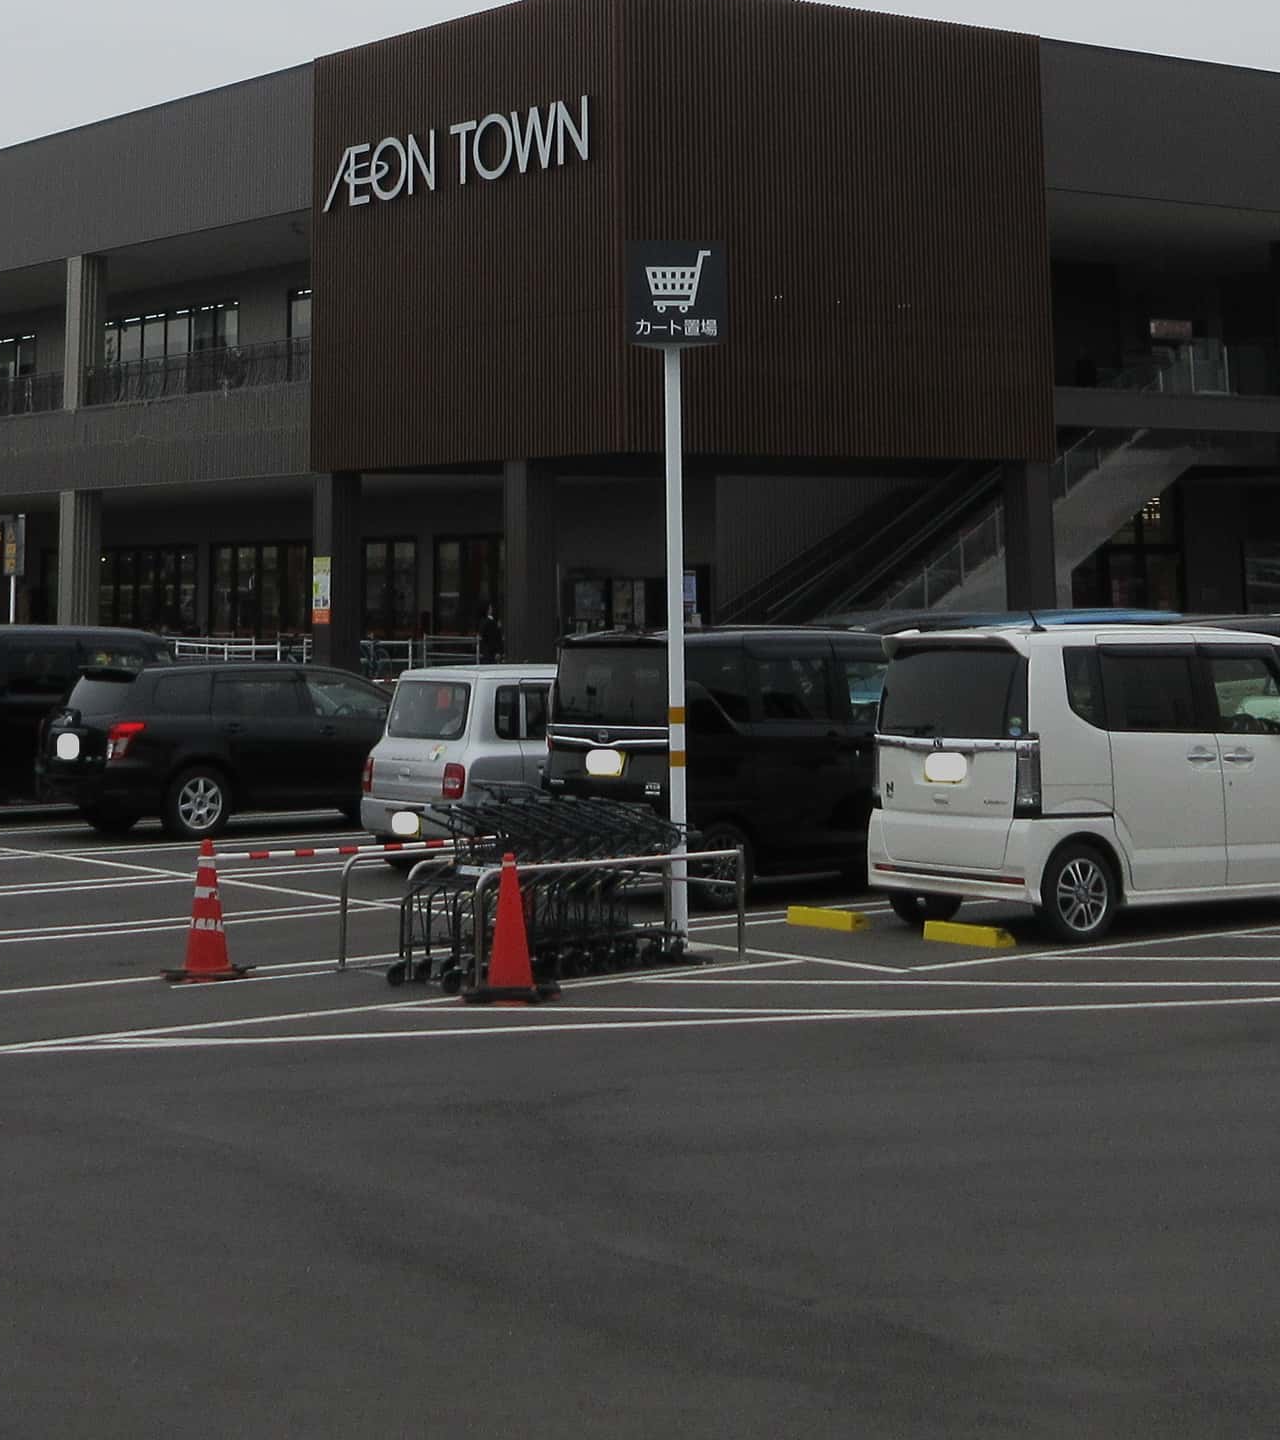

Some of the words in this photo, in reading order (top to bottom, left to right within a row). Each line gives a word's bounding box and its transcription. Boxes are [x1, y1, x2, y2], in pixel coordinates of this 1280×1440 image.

[450, 95, 589, 184] TOWN
[635, 319, 718, 337] カート置場
